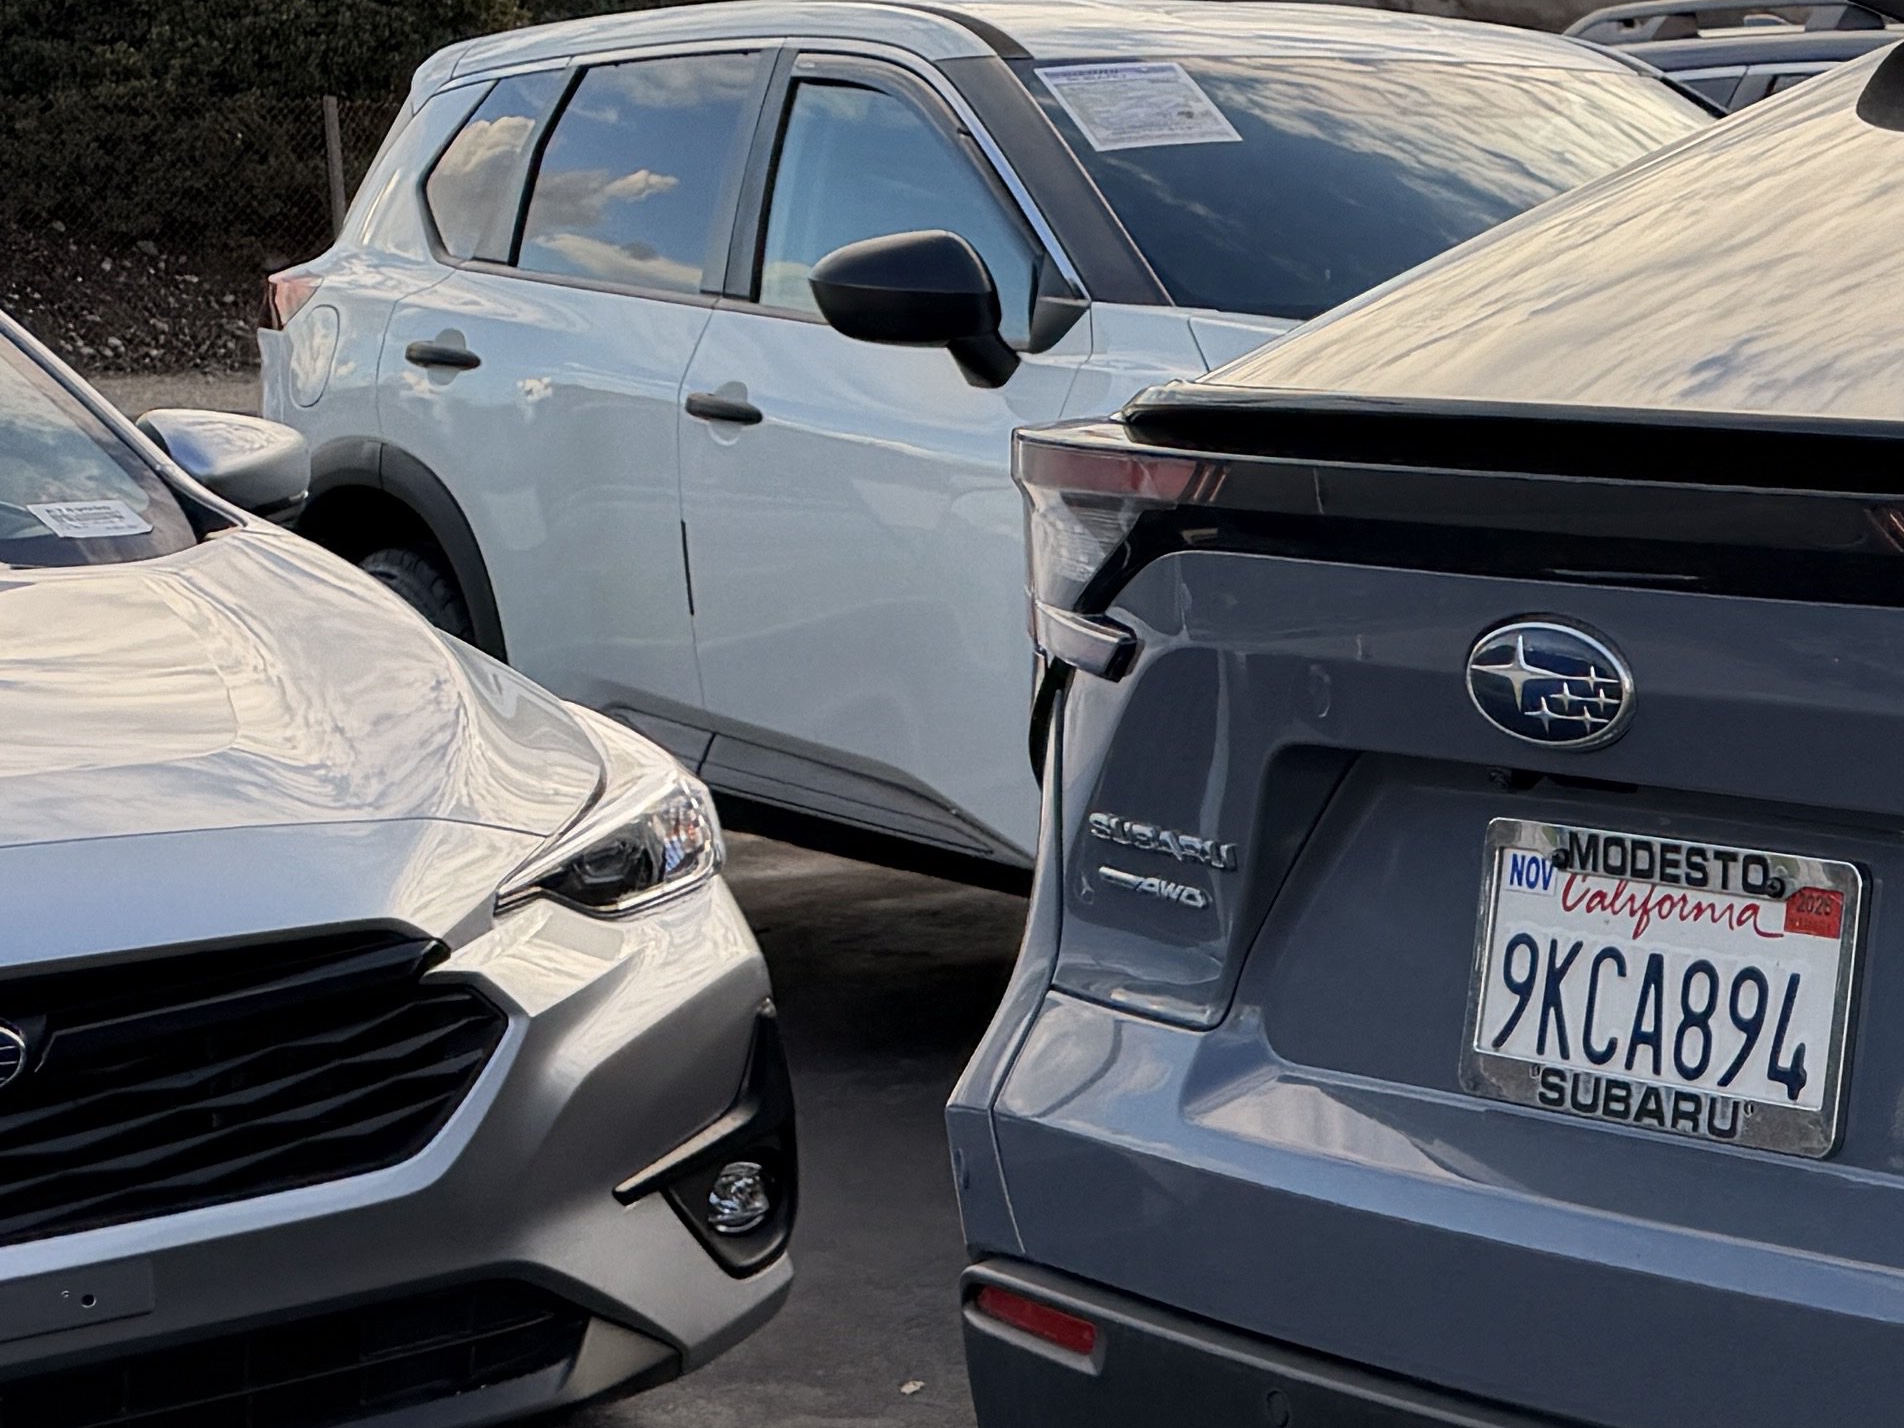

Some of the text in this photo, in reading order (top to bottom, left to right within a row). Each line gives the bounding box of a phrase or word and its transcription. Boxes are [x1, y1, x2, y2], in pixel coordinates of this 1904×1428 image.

[1509, 853, 1554, 891] NOV
[1568, 831, 1770, 895] MODESTO
[1561, 872, 1784, 940] California
[1491, 932, 1807, 1100] 9KCA894
